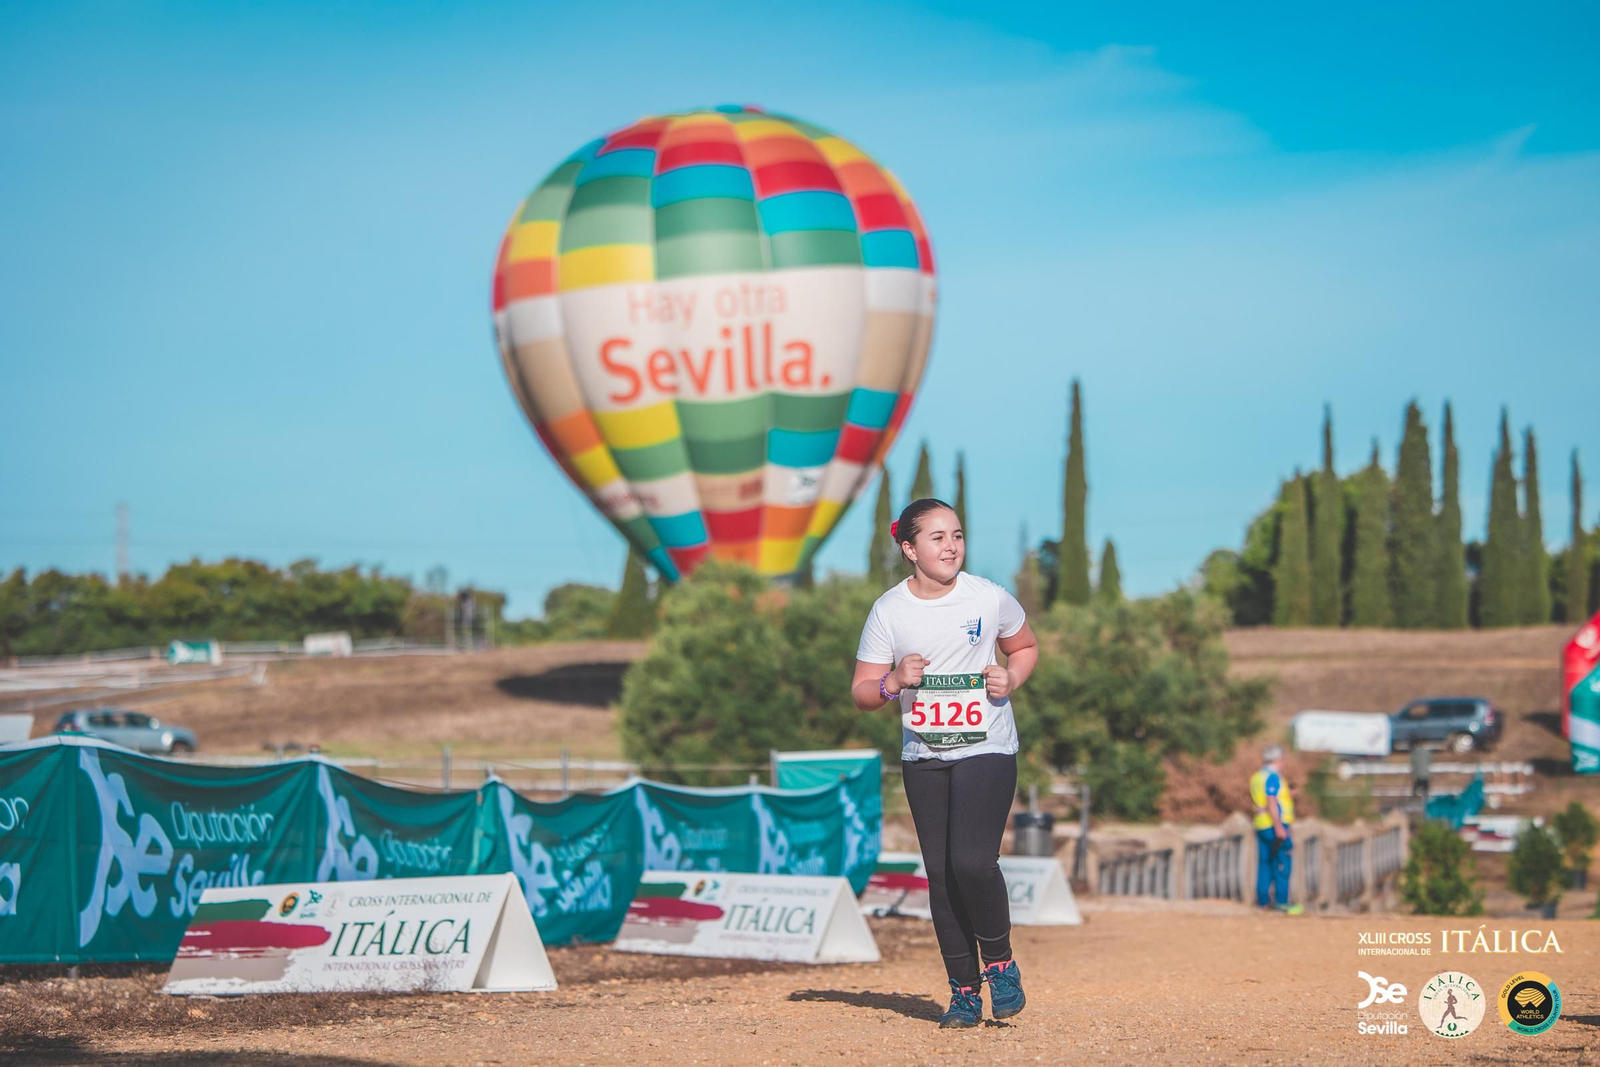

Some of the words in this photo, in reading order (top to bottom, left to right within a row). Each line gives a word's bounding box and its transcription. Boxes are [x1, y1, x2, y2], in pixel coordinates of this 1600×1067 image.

[626, 286, 698, 329] Hay
[714, 282, 788, 318] otra
[599, 321, 832, 405] Sevilla.
[926, 674, 965, 686] ITÁLICA
[911, 701, 983, 727] 5126
[171, 801, 274, 850] Diputación
[348, 896, 384, 908] CROSS
[384, 892, 473, 907] INTERNACIONAL
[477, 891, 494, 903] DE
[724, 898, 816, 935] ITÁLICA
[329, 910, 471, 957] ITÁLICA
[322, 961, 392, 972] INTERNATIONAL
